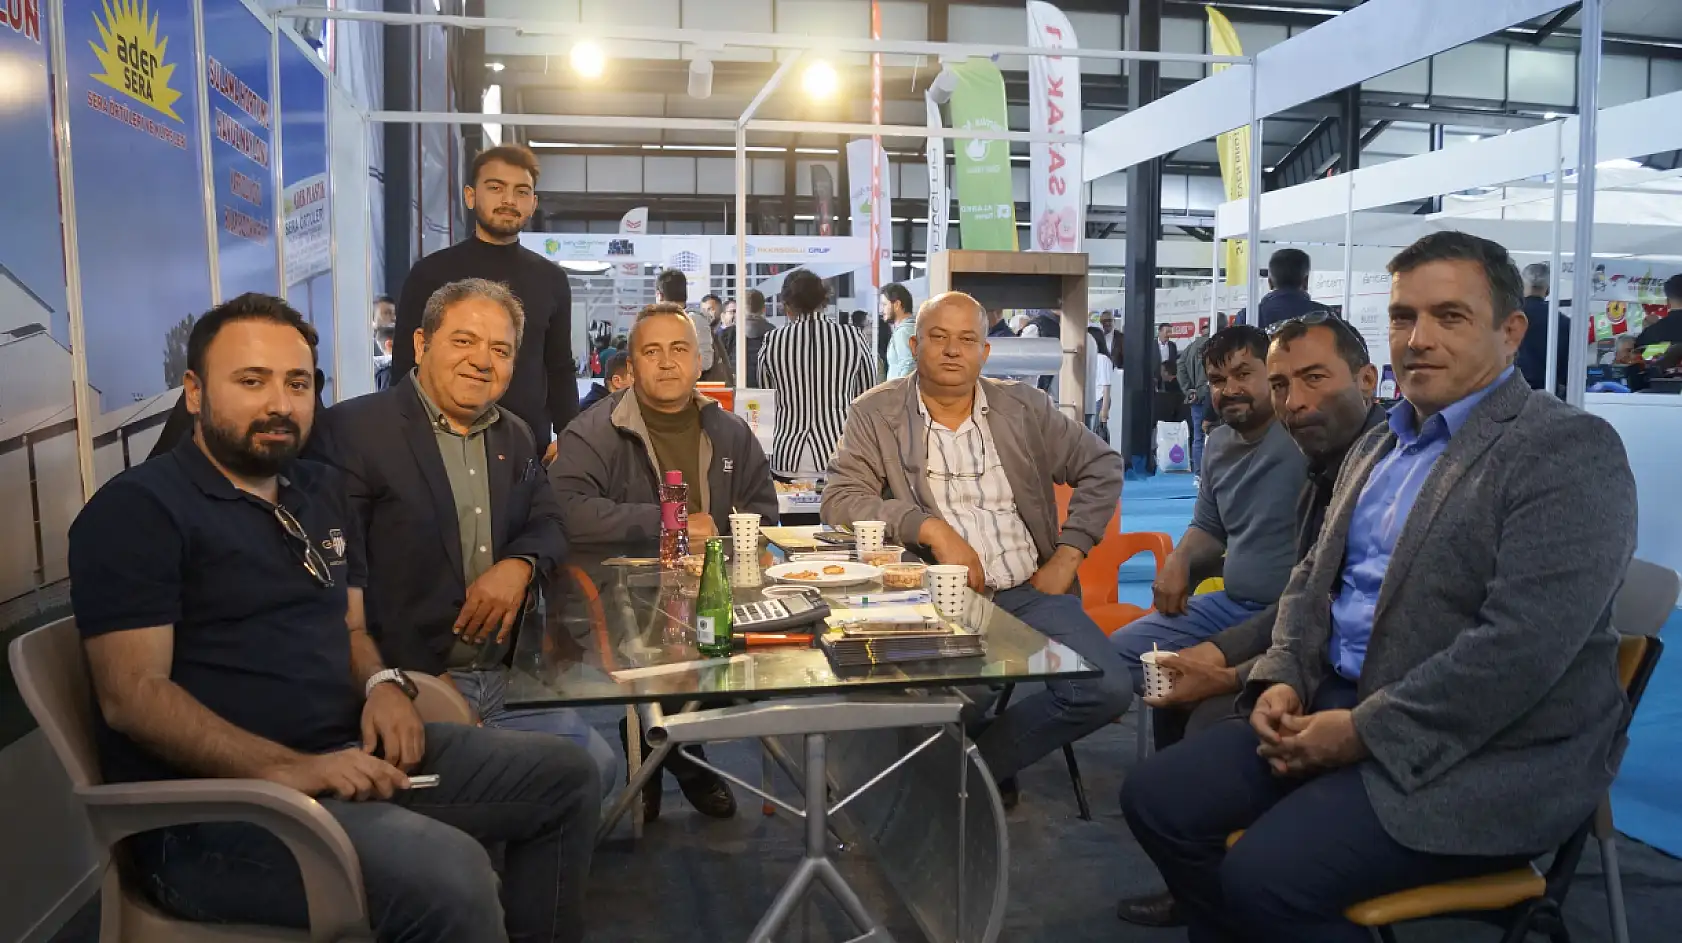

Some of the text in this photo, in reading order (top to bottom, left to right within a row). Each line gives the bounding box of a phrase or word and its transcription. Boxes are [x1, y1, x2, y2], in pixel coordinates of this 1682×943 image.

[116, 33, 158, 78] ader
[87, 89, 108, 112] SERA
[123, 66, 154, 102] SERA
